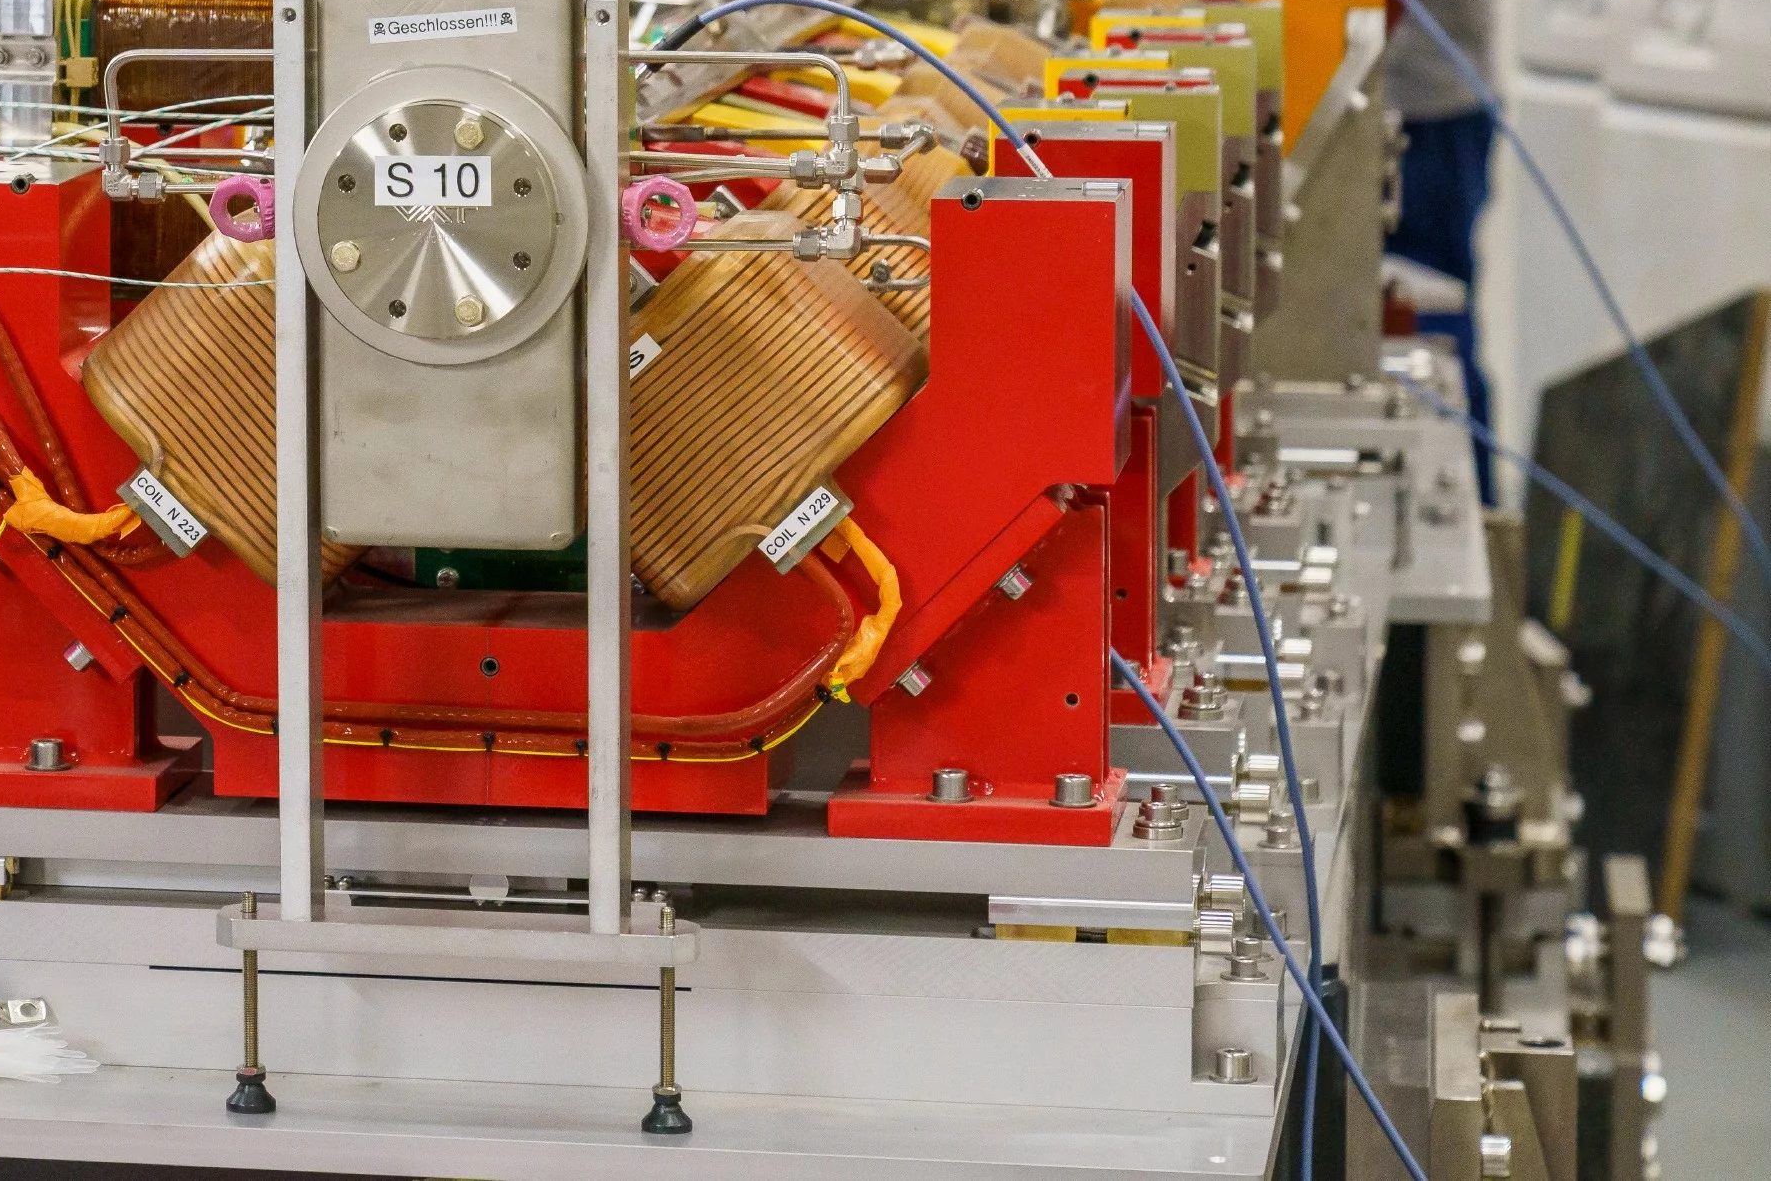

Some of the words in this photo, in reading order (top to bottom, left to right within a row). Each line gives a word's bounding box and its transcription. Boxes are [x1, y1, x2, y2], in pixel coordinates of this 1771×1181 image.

[388, 13, 498, 35] Geschlossen!!!
[387, 162, 414, 198] S
[433, 162, 480, 198] 10
[137, 477, 163, 507] COIL
[167, 507, 180, 521] N
[178, 519, 200, 541] 223
[766, 528, 797, 555] COIL
[797, 512, 810, 526] N
[809, 492, 831, 515] 229
